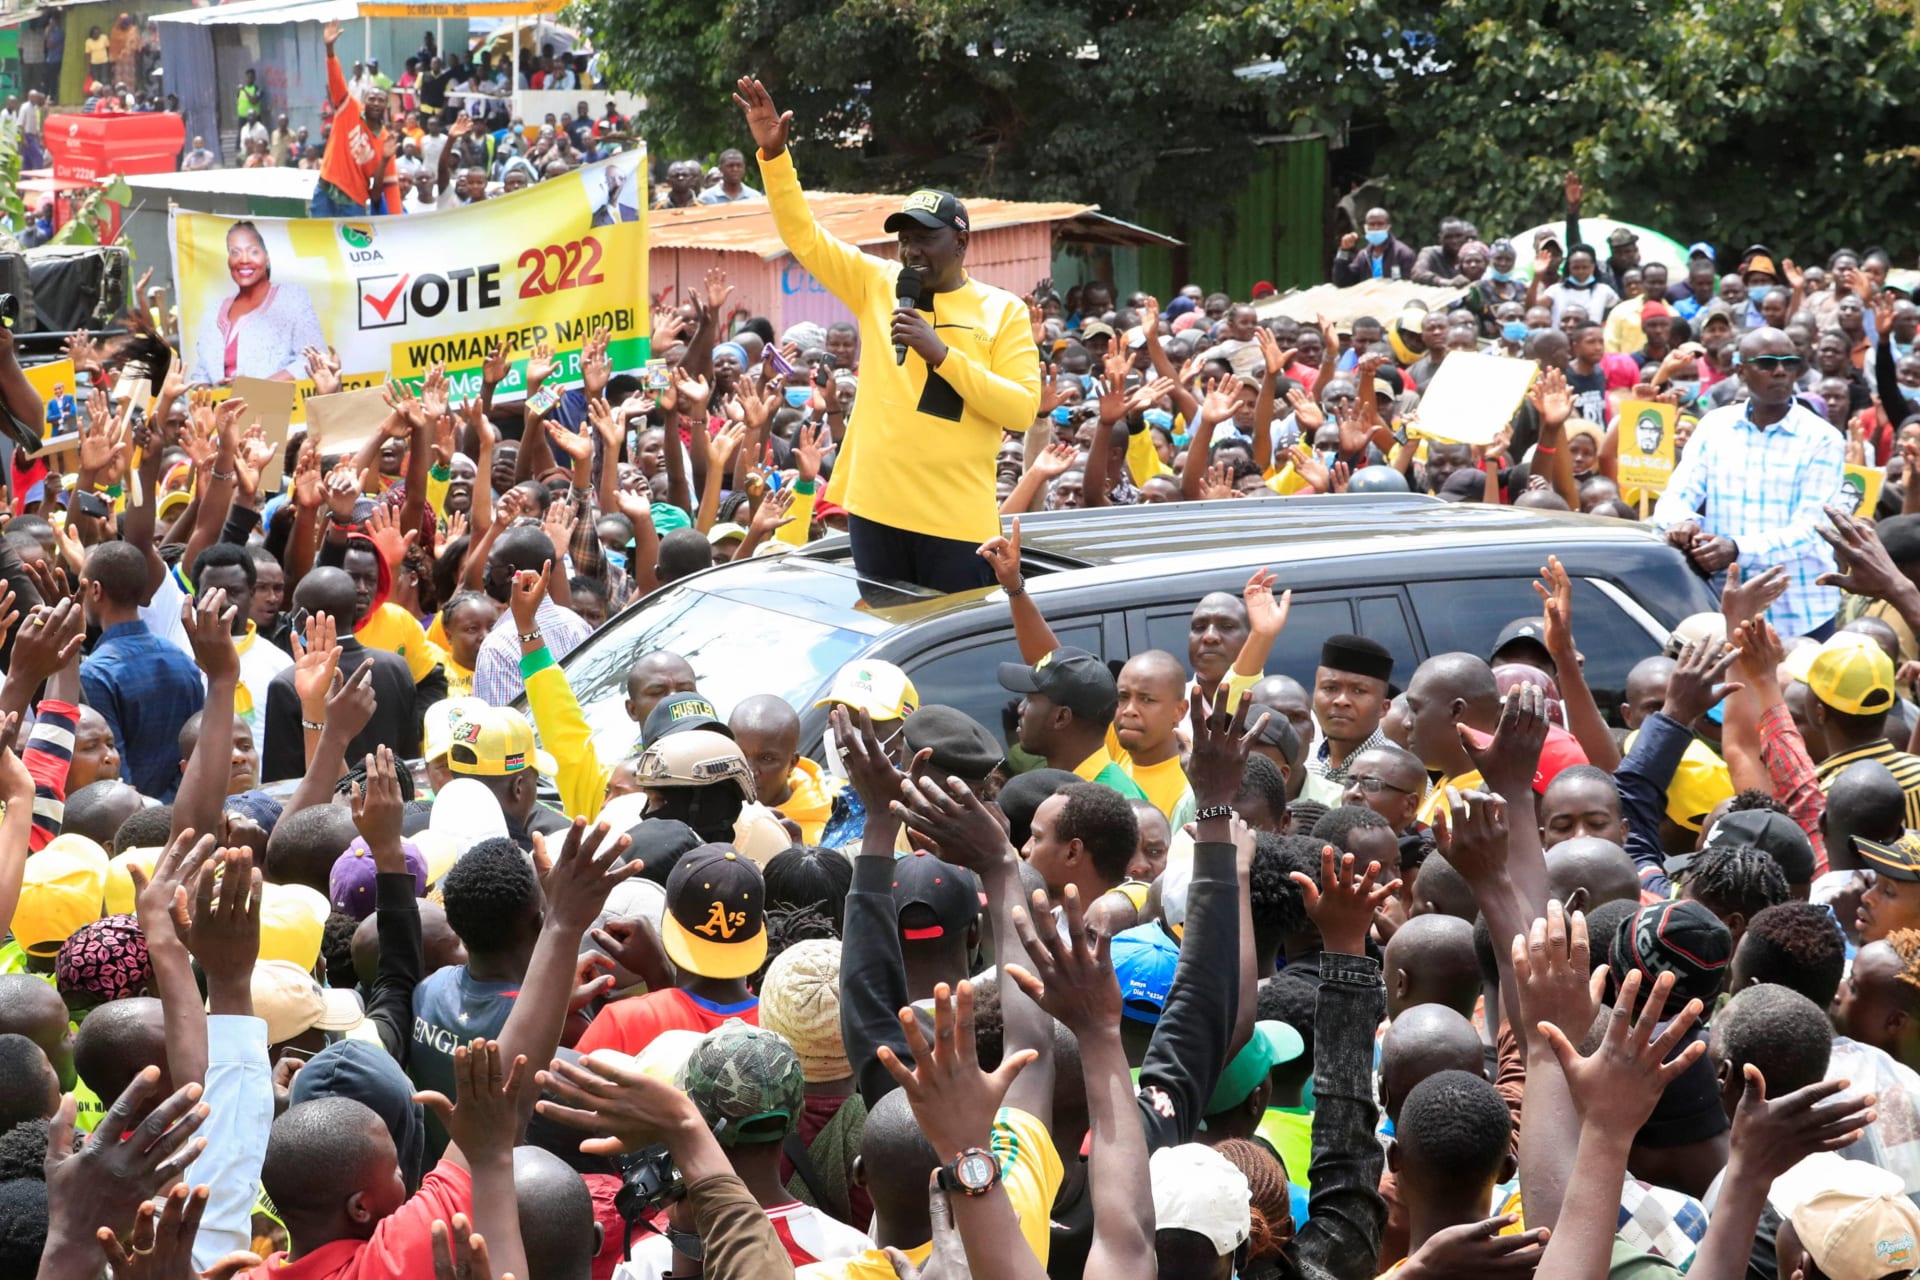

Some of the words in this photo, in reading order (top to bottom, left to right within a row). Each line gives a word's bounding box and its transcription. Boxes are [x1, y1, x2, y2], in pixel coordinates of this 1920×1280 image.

[349, 250, 384, 262] UDA
[517, 236, 605, 299] 2022
[408, 334, 500, 368] WOMAN
[506, 325, 548, 351] REP
[453, 722, 481, 744] #1
[694, 901, 746, 938] A's
[413, 1015, 489, 1065] ENGL
